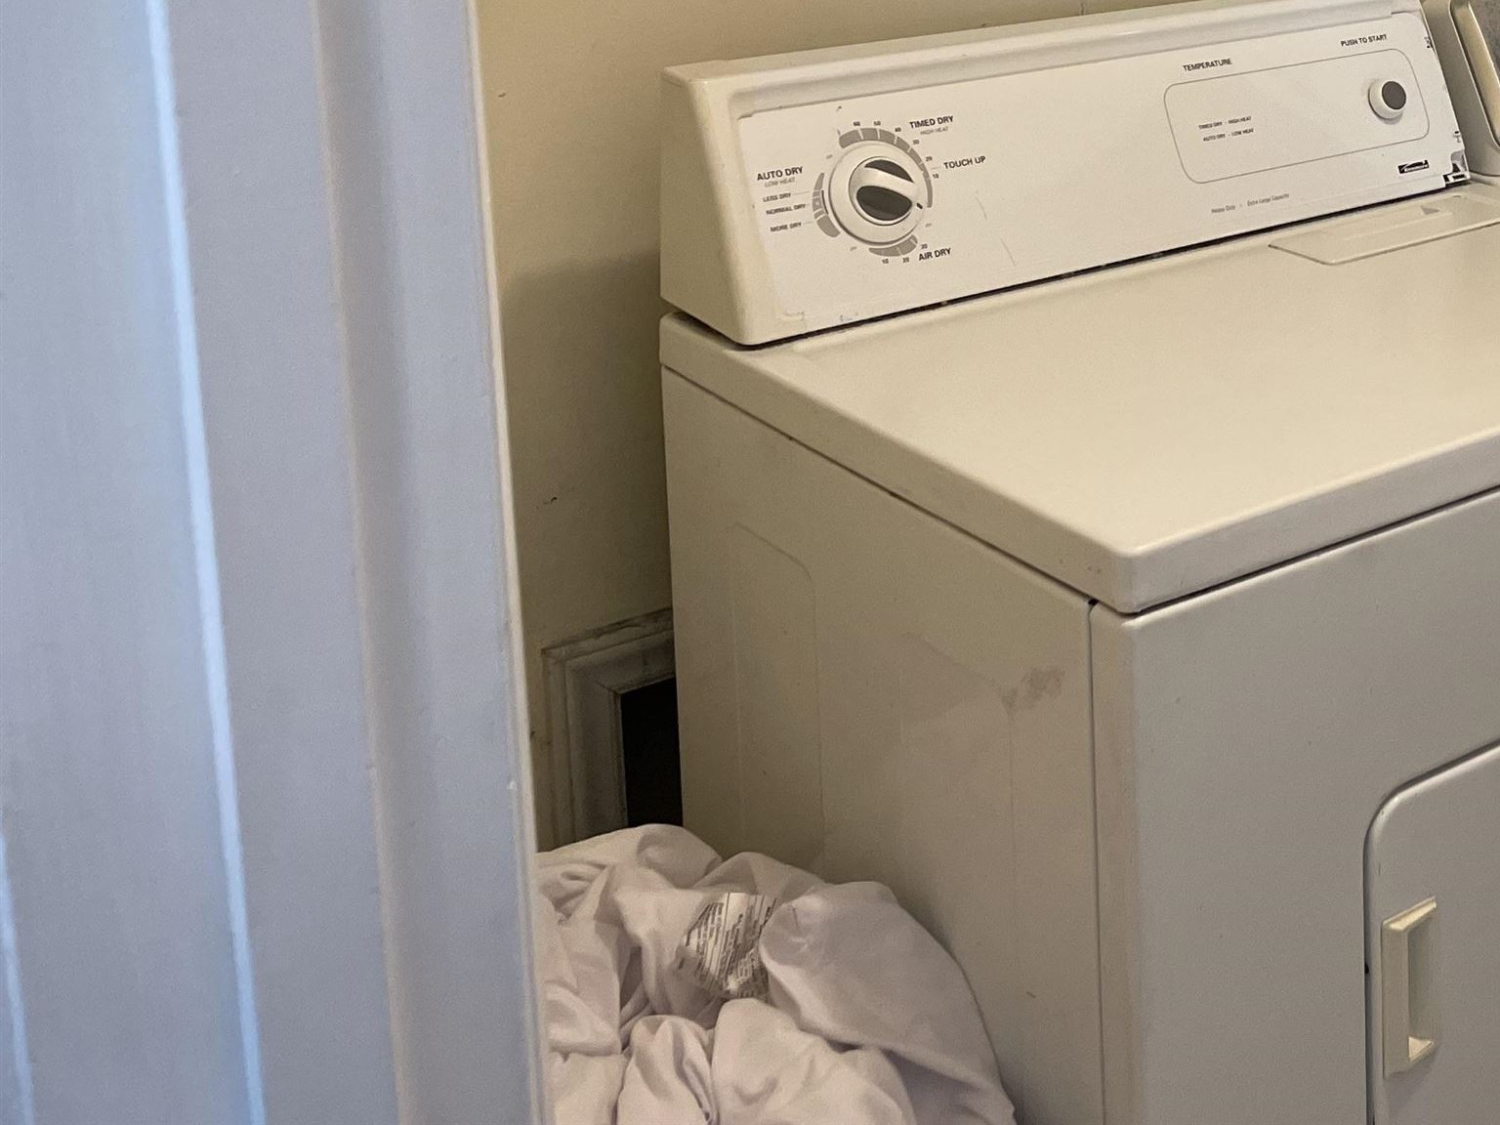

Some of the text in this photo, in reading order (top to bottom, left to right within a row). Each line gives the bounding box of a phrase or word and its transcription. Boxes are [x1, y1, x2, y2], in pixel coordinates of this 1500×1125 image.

[1368, 34, 1387, 43] START
[1183, 58, 1232, 72] TEMPERATURE
[909, 115, 954, 129] TIMED DRY
[943, 156, 987, 170] TOUCH UP
[757, 166, 804, 181] AUTO DRY
[919, 247, 952, 262] AIR DRY
